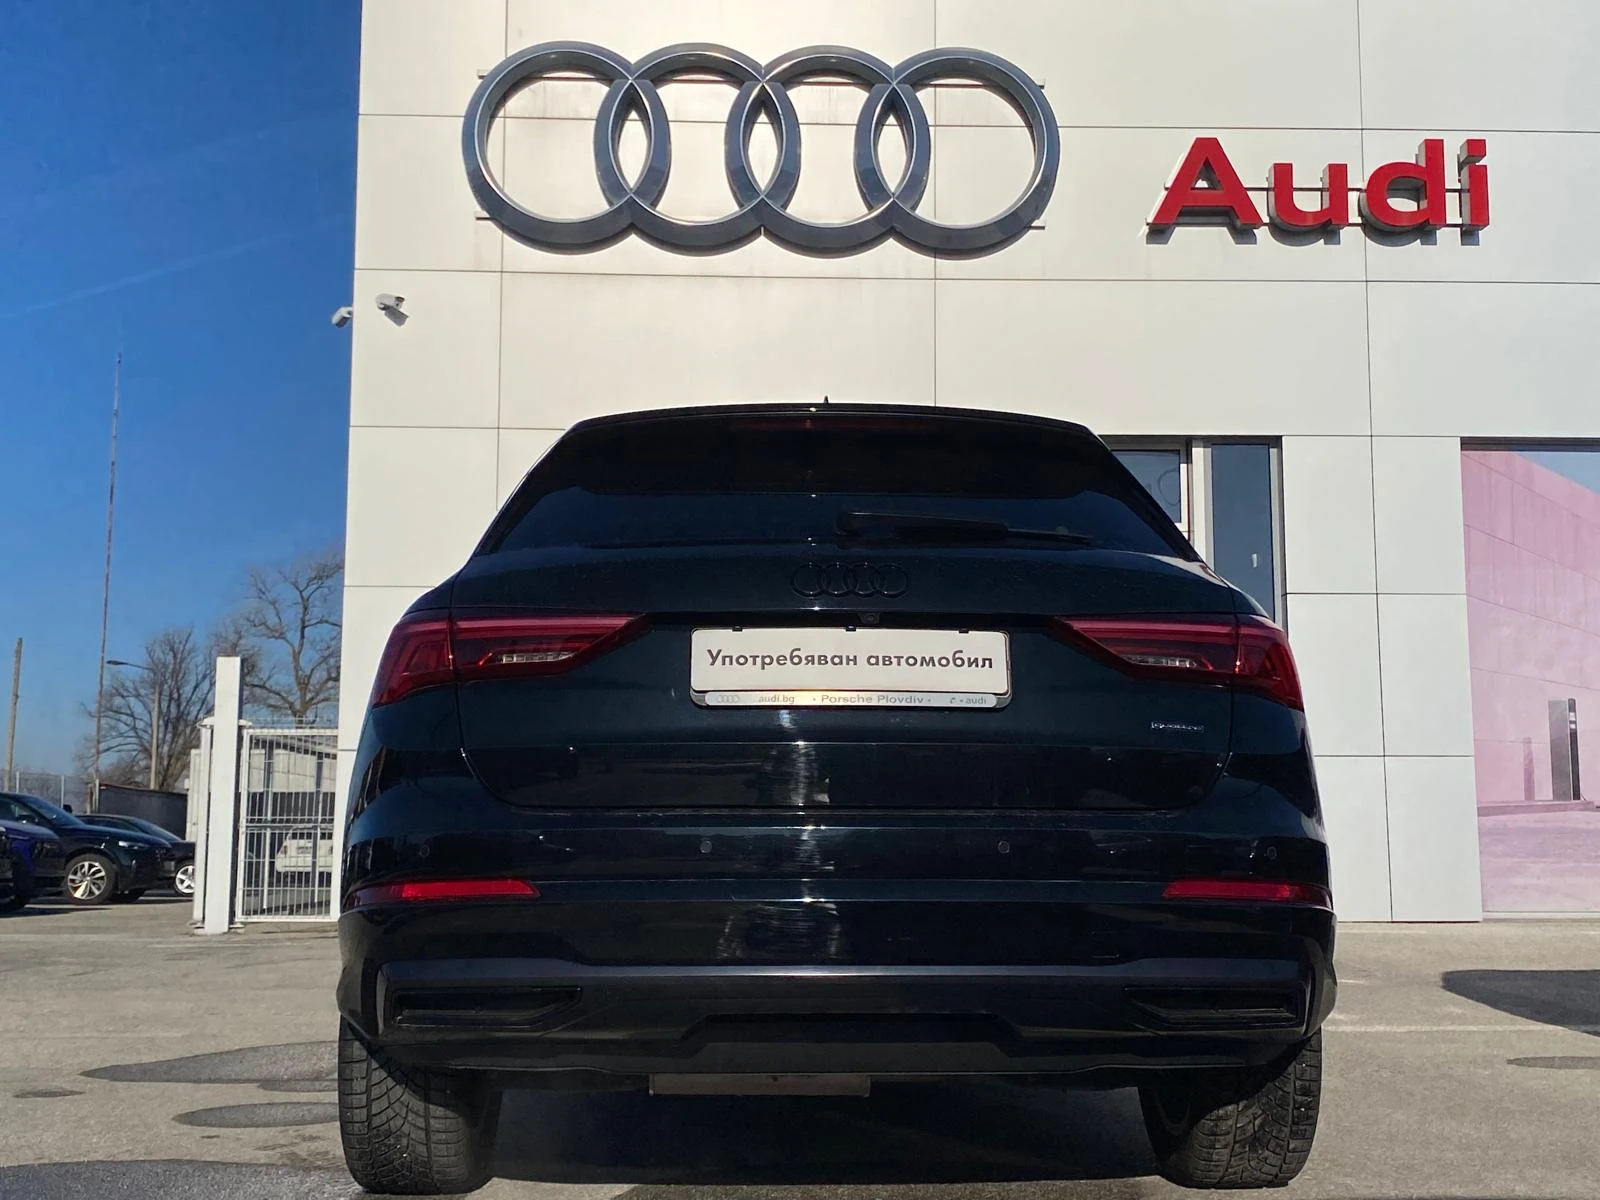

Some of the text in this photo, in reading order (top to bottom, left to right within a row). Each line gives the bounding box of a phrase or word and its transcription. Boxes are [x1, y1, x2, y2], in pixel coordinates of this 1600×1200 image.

[1149, 137, 1490, 230] Audi
[706, 648, 993, 670] Употребяван автомобил
[821, 694, 873, 704] Porsche
[877, 695, 924, 704] Plovdiv
